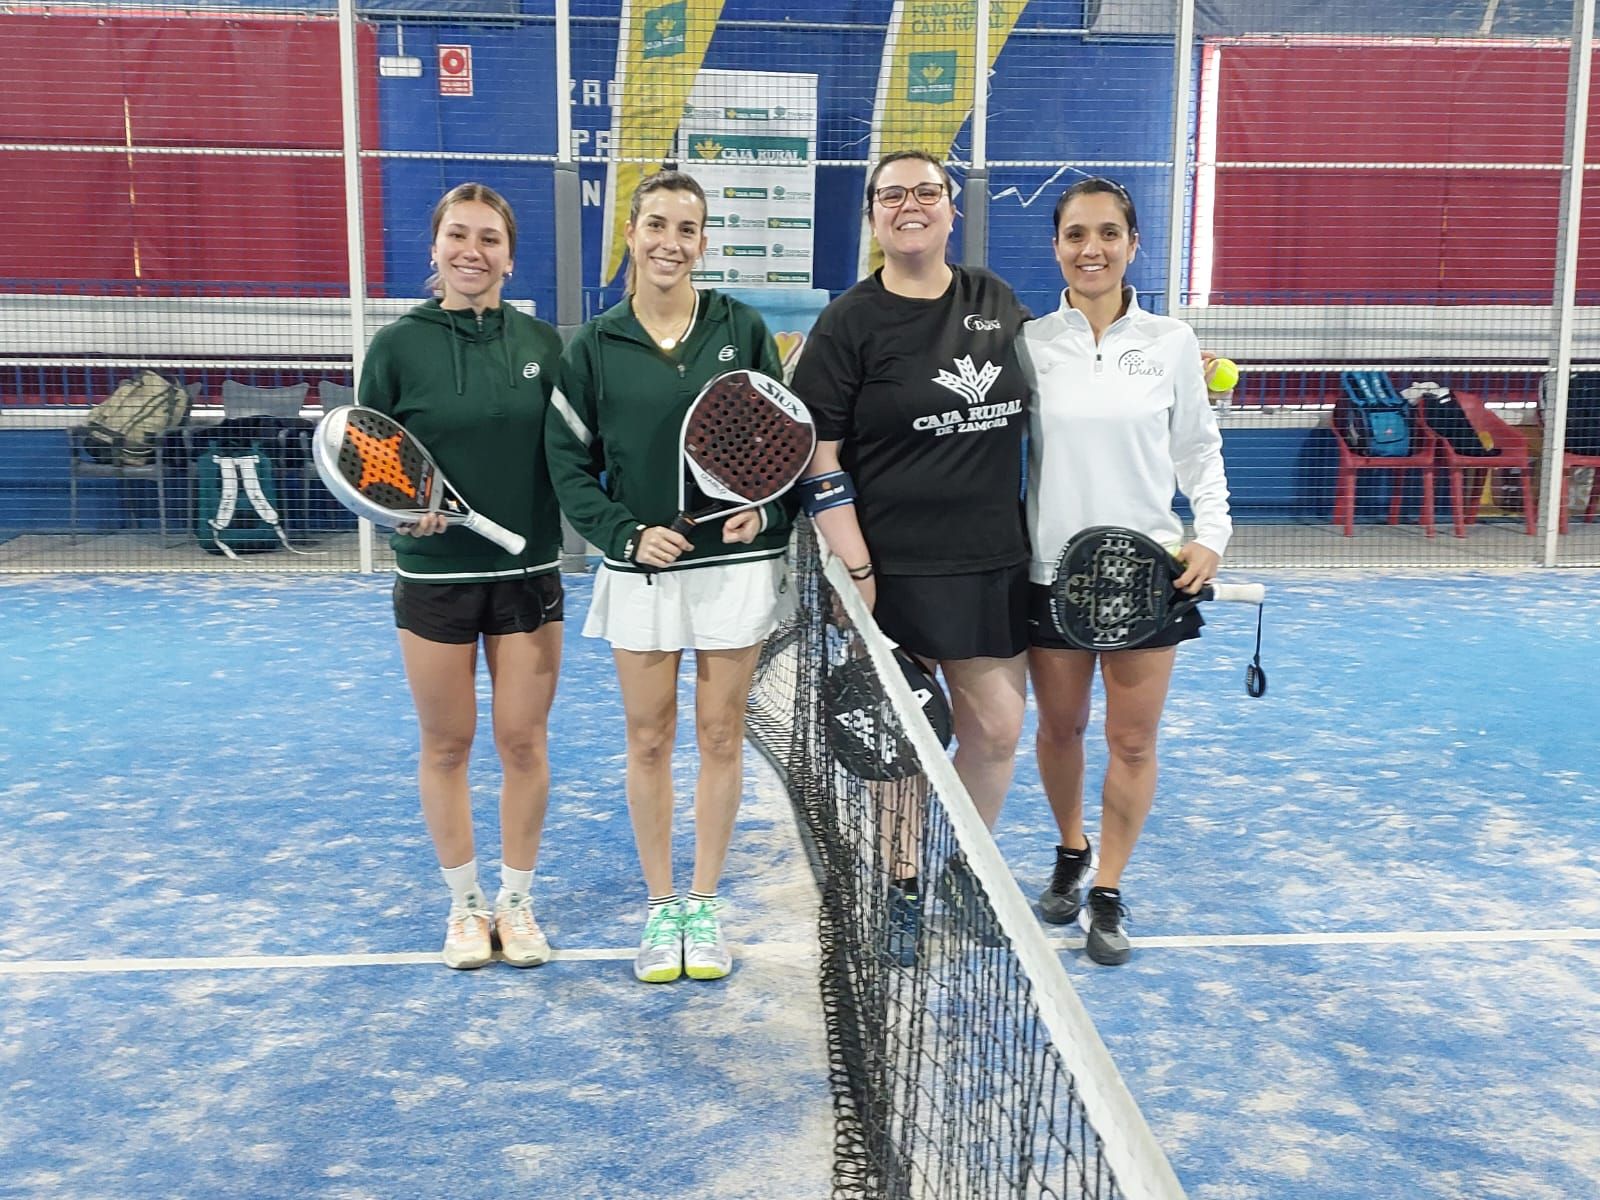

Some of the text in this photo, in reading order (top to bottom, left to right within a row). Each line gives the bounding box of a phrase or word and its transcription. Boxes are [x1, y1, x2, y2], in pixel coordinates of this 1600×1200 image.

[721, 147, 803, 161] CAJA RURAL
[757, 381, 801, 417] SIUX
[912, 399, 1023, 431] CAJA RURAL
[935, 425, 955, 437] DE
